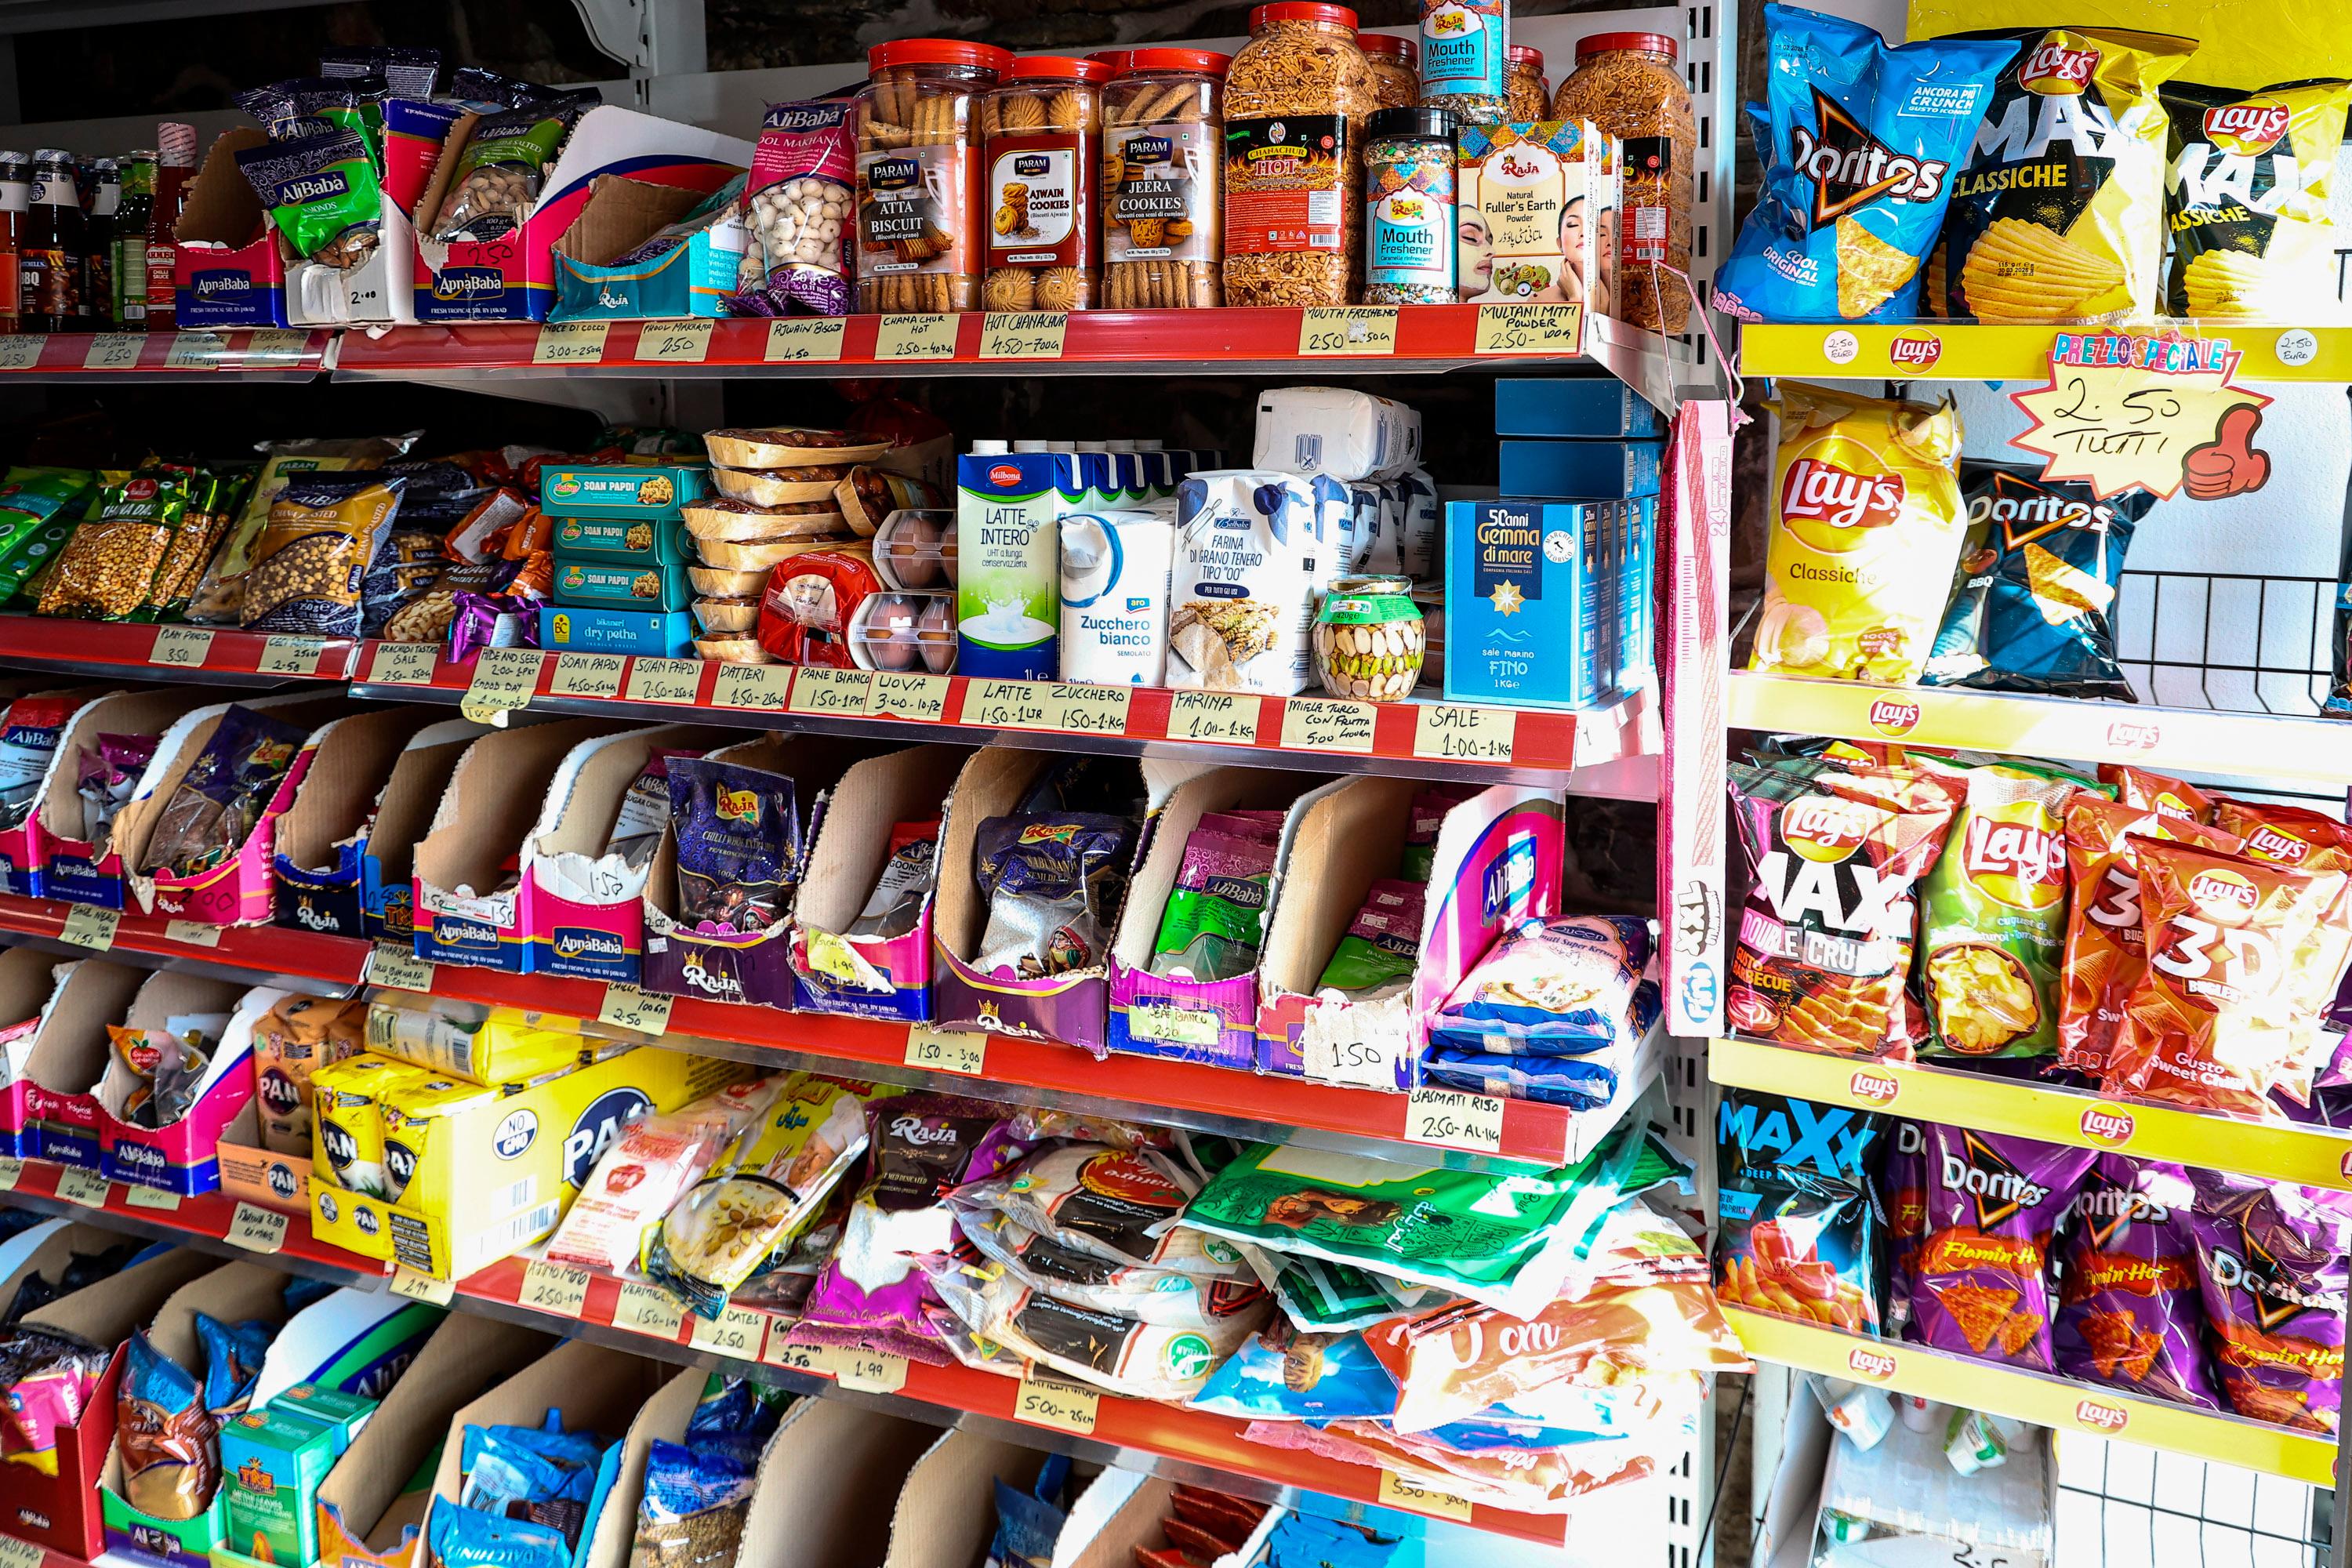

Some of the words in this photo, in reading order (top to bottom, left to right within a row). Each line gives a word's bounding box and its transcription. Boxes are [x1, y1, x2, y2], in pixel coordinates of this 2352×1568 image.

[1428, 40, 1475, 56] Mouth
[1428, 55, 1475, 66] Freshener
[2024, 43, 2098, 80] Lay's
[1914, 86, 1958, 98] ANCORA
[1911, 96, 1974, 109] CRUNCH
[2207, 106, 2290, 143] Lay's
[1130, 141, 1167, 153] PARAM
[1249, 146, 1305, 158] CHANACHUR
[873, 162, 915, 179] PARAM
[1018, 159, 1047, 169] PARAM
[1254, 158, 1298, 176] HOT
[1793, 129, 1950, 201] Doritos
[1127, 181, 1172, 194] JEERA
[1951, 164, 2067, 200] CLASSICHE
[1029, 188, 1065, 199] AJWAIN
[880, 201, 914, 214] ATTA
[1029, 199, 1069, 211] COOKIES
[1120, 198, 1181, 212] COOKIES
[1486, 201, 1523, 214] Fuller's
[1527, 199, 1556, 211] Earth
[870, 218, 924, 233] BISCUIT
[1506, 214, 1534, 223] Powder
[1382, 228, 1433, 245] Mouth
[1381, 243, 1433, 256] Freshener
[1762, 246, 1818, 282] ORIGINAL
[1786, 250, 1819, 270] COOL
[1481, 305, 1538, 318] MULTANI
[1542, 305, 1577, 317] MITTI
[581, 324, 605, 332] COCCO
[911, 325, 929, 334] HOT
[1506, 318, 1558, 328] POWDER
[1893, 339, 1938, 363] Lay's
[2053, 332, 2131, 364] PREZZO
[2132, 338, 2227, 372] SPECIALE
[989, 470, 1021, 481] Milbona
[583, 481, 607, 492] SOAN
[608, 481, 635, 492] PAPDI
[1784, 461, 1900, 528] Lay's
[985, 508, 1027, 526] LATTE
[1967, 495, 2114, 533] Doritos
[583, 526, 602, 536] SOAN
[604, 527, 622, 537] PAPDI
[981, 528, 1029, 546] INTERO
[1477, 522, 1540, 546] Gemma
[1212, 535, 1243, 550] FARINA
[1190, 550, 1196, 563] DI
[1200, 550, 1229, 564] GRANO
[1232, 552, 1262, 566] TENERO
[1483, 546, 1495, 562] di
[1498, 550, 1533, 563] mare
[982, 558, 1028, 568] conservazione
[587, 575, 607, 584] SOAN
[608, 575, 629, 585] PAPDI
[1203, 566, 1221, 579] TIPO
[1789, 563, 1877, 586] Classiche
[1967, 575, 1994, 589] BBQ
[1131, 597, 1145, 607] aro
[554, 622, 568, 633] BC
[1080, 615, 1151, 630] Zucchero
[583, 627, 604, 642] dry
[606, 628, 637, 641] petha
[1099, 631, 1151, 647] bianco
[394, 655, 417, 664] SALE
[481, 650, 499, 660] HIDE
[519, 653, 540, 665] SEEK
[1482, 648, 1501, 658] sale
[1504, 651, 1534, 659] marino
[560, 655, 587, 669] SOAN
[634, 659, 665, 673] SOAN
[1489, 661, 1528, 677] FINO
[720, 666, 765, 683] DATTERI
[800, 668, 833, 681] PANE
[834, 672, 870, 684] BIANCO
[505, 683, 522, 692] DAY
[879, 678, 927, 691] UOVA
[983, 686, 1033, 700] LATTE
[1051, 684, 1125, 702] ZUCCHERO
[1175, 691, 1232, 710] FARINA
[1305, 715, 1334, 725] CON
[1429, 707, 1479, 728] SALE
[1871, 700, 1917, 726] Lay's
[2110, 721, 2161, 748] Lay's
[1786, 804, 1862, 848] Lay's
[1969, 816, 2067, 884] Lay's
[2252, 829, 2307, 860] Lay's
[2193, 877, 2256, 908] Lay's
[1740, 908, 1800, 959] DOUBLE
[1561, 939, 1588, 949] Super
[1736, 946, 1763, 971] GUSTO
[1732, 961, 1792, 993] BARBECUE
[1154, 1038, 1182, 1047] TROPICAL
[1208, 1046, 1229, 1054] JAWAD
[2175, 1051, 2225, 1074] Gusto
[1854, 1075, 1896, 1098] Lay's
[507, 1116, 524, 1131] NO
[2082, 1111, 2132, 1138] Lay's
[503, 1132, 528, 1154] GMO
[1747, 1170, 1772, 1180] DEEP
[1941, 1156, 2051, 1208] Doritos
[727, 1310, 760, 1326] DATES
[1176, 1345, 1204, 1357] VEGAN
[1851, 1348, 1896, 1372] Lay's
[2081, 1403, 2128, 1425] Lay's
